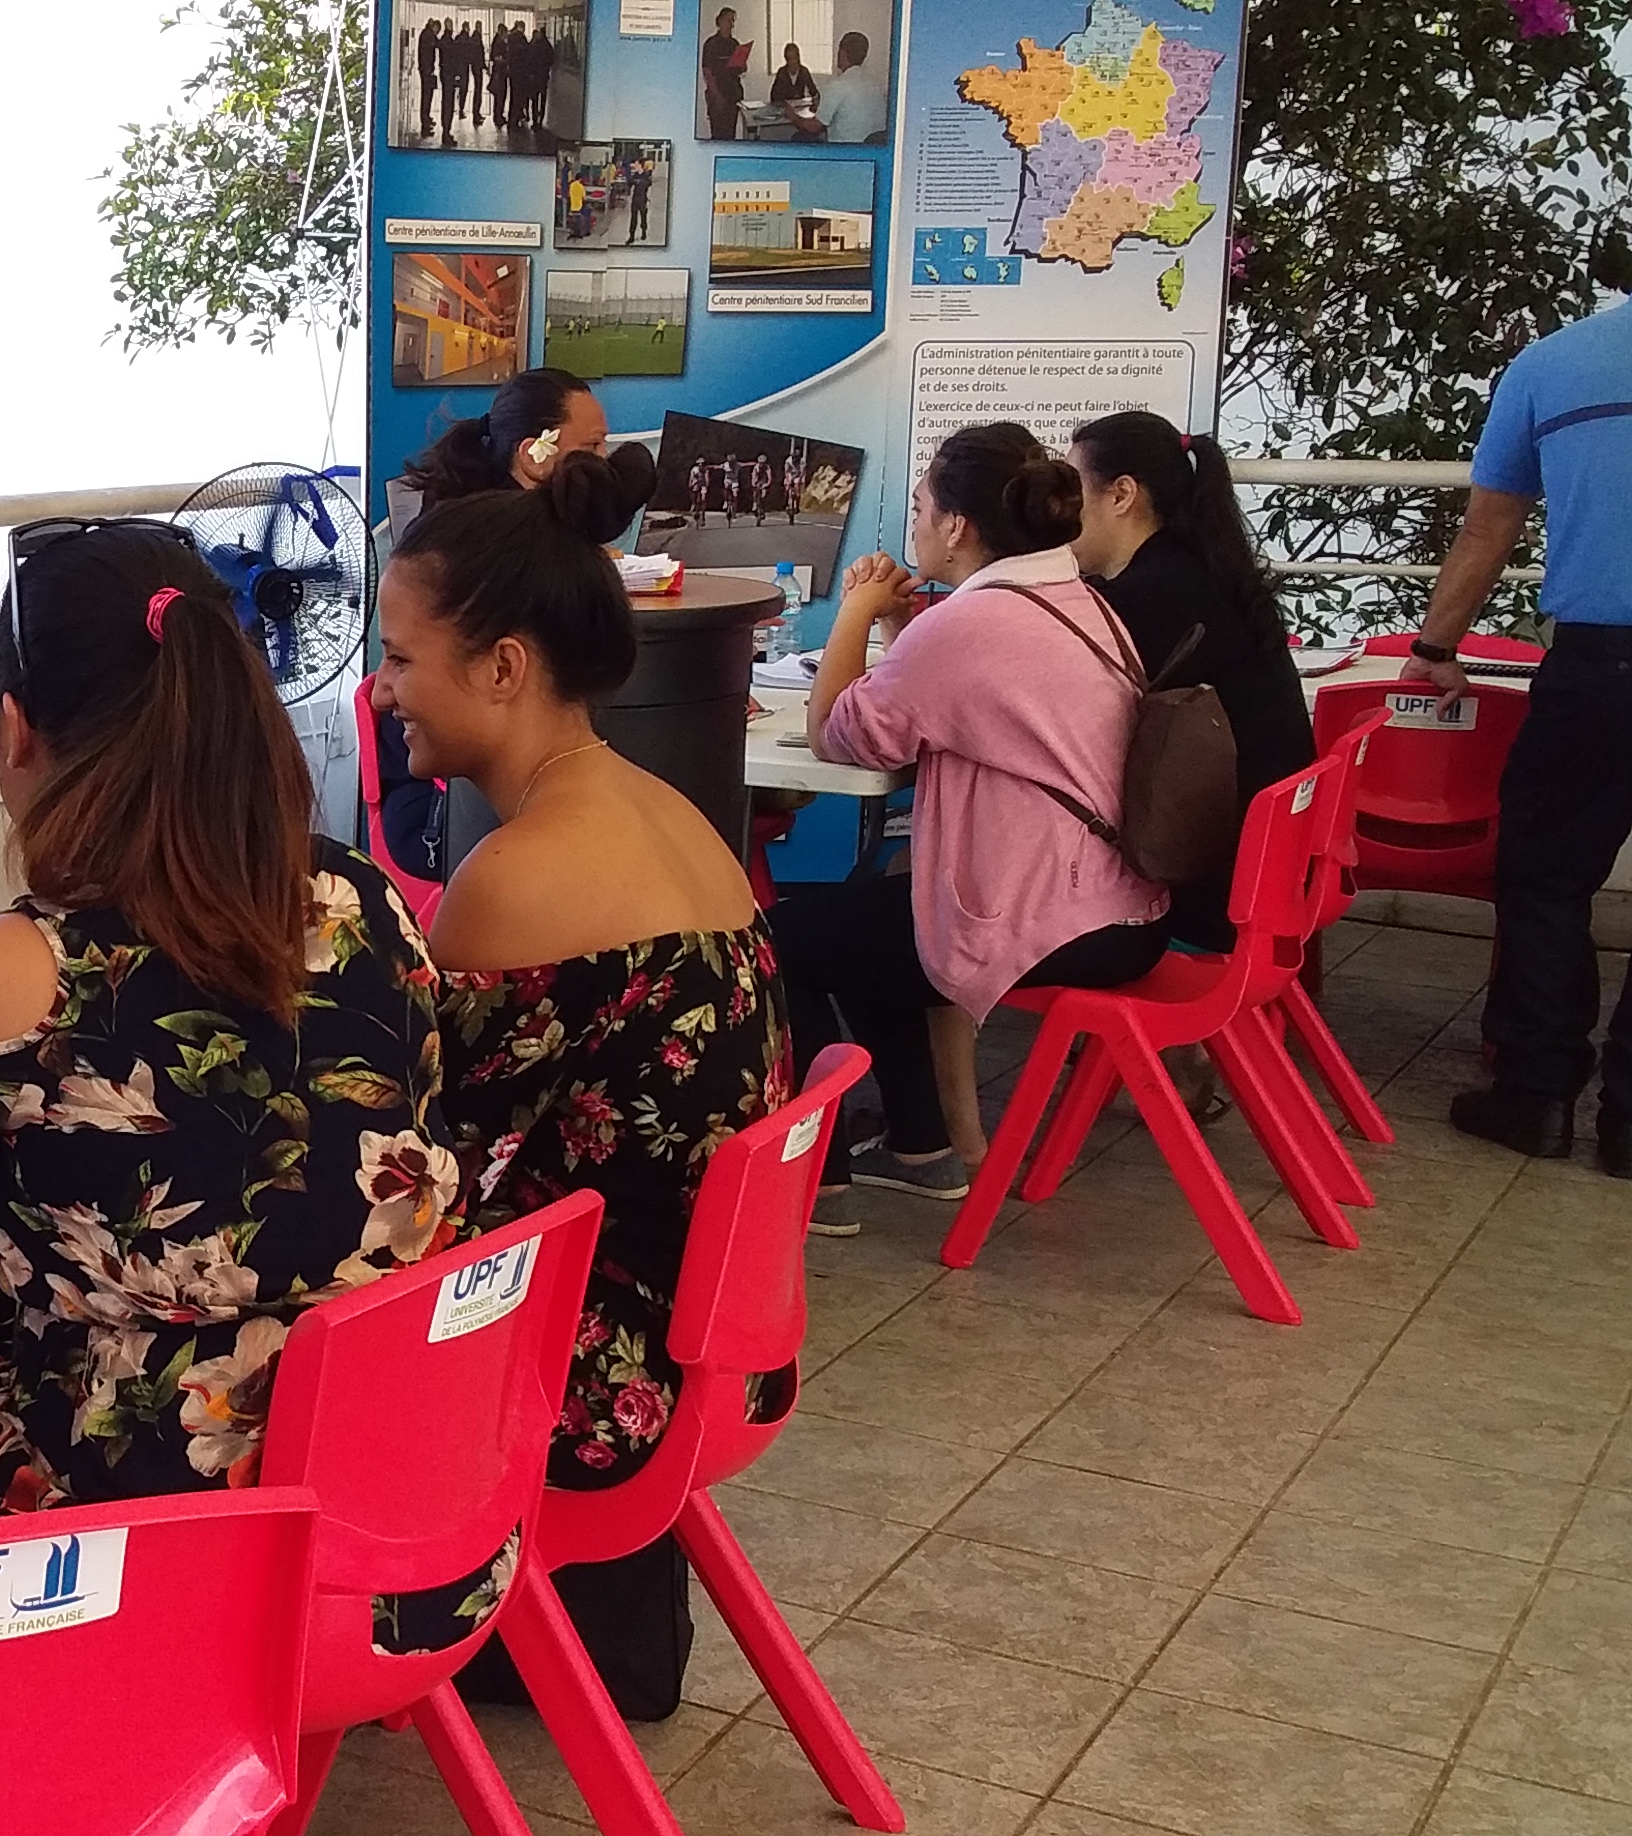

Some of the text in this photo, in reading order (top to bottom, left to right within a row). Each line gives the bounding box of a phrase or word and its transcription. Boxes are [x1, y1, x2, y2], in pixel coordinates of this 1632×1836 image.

[387, 223, 413, 236] Centre
[414, 225, 466, 239] pénitentiaire
[468, 225, 480, 237] de
[711, 293, 869, 308] Centre pénitentiaire Sud Francilien
[921, 347, 1185, 361] L'administration pénitentiaire garantit à toute
[919, 363, 1163, 378] personne détenue le respect de sa dignité
[918, 380, 1009, 392] et de ses droits.
[918, 400, 973, 412] L'exercice
[975, 400, 990, 411] de
[992, 400, 1034, 412] ceux-ci
[1036, 402, 1052, 411] ne
[1054, 401, 1082, 414] peut
[1084, 400, 1111, 412] faire
[917, 416, 964, 428] d'autres
[1033, 419, 1058, 430] que
[1049, 433, 1057, 444] à
[1059, 433, 1069, 444] la
[915, 449, 932, 461] du
[1395, 696, 1438, 714] UPF
[453, 1251, 509, 1301] UPF
[7, 1608, 86, 1634] FRANÇAISE
